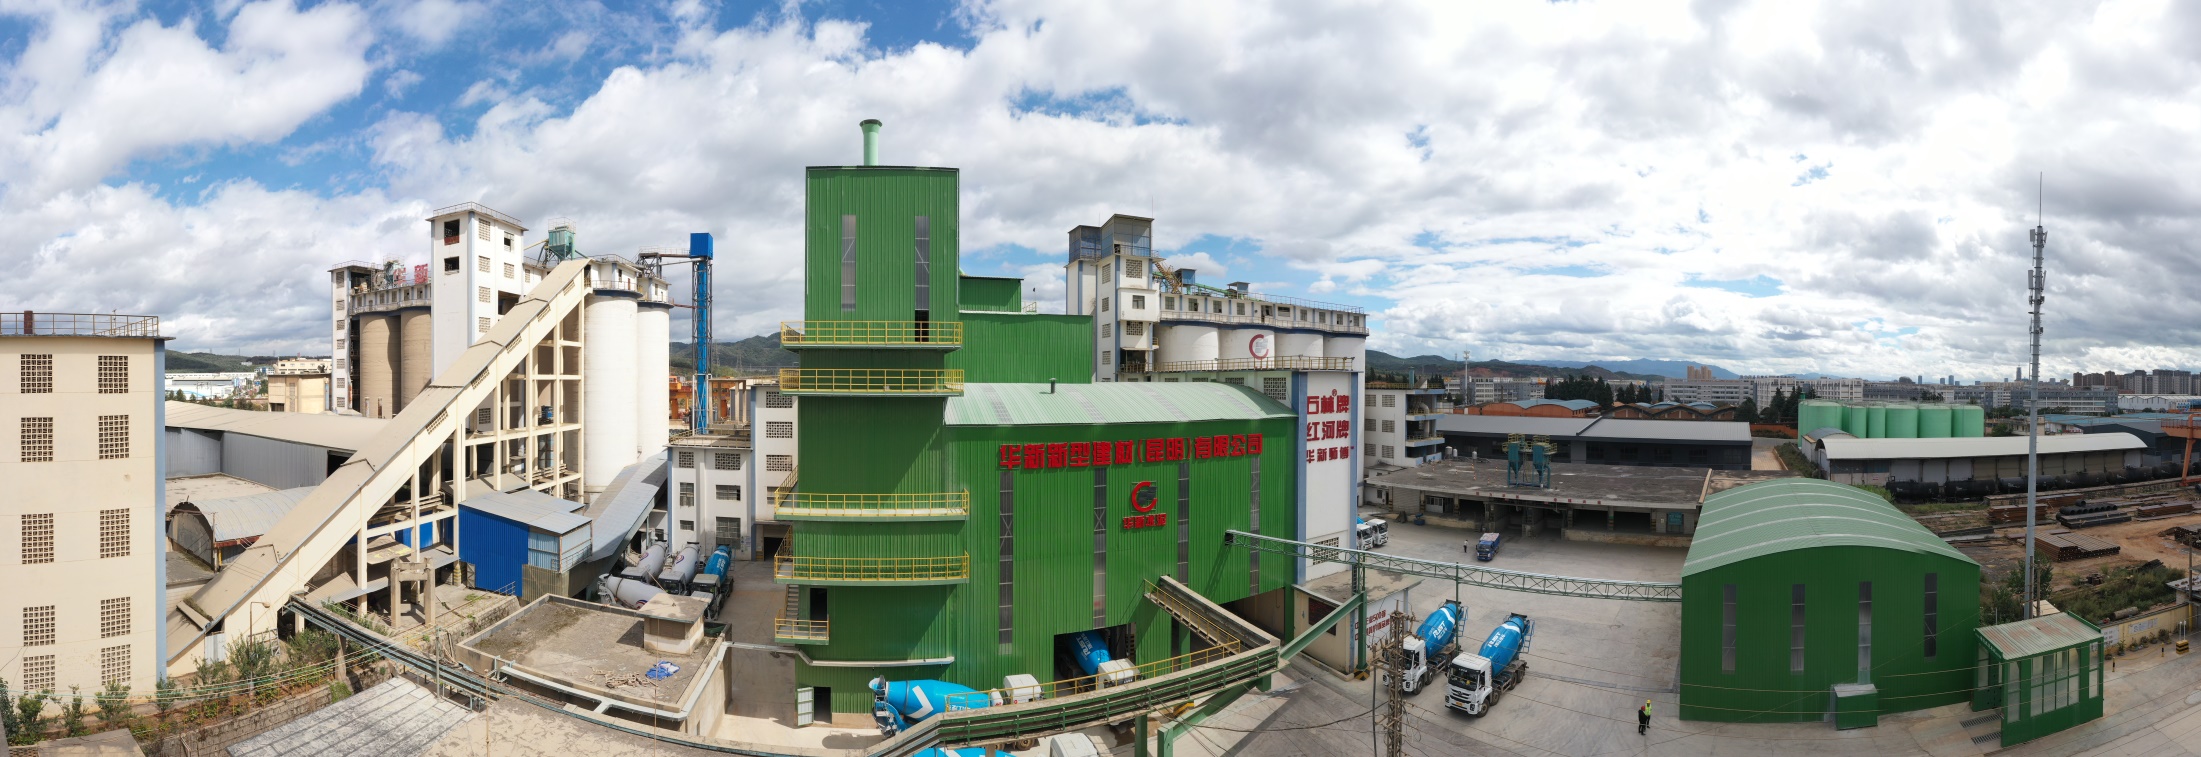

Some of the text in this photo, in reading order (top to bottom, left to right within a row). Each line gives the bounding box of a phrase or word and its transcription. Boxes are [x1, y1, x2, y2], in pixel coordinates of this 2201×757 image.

[1307, 395, 1350, 415] 石林牌
[1307, 420, 1350, 441] 红河牌
